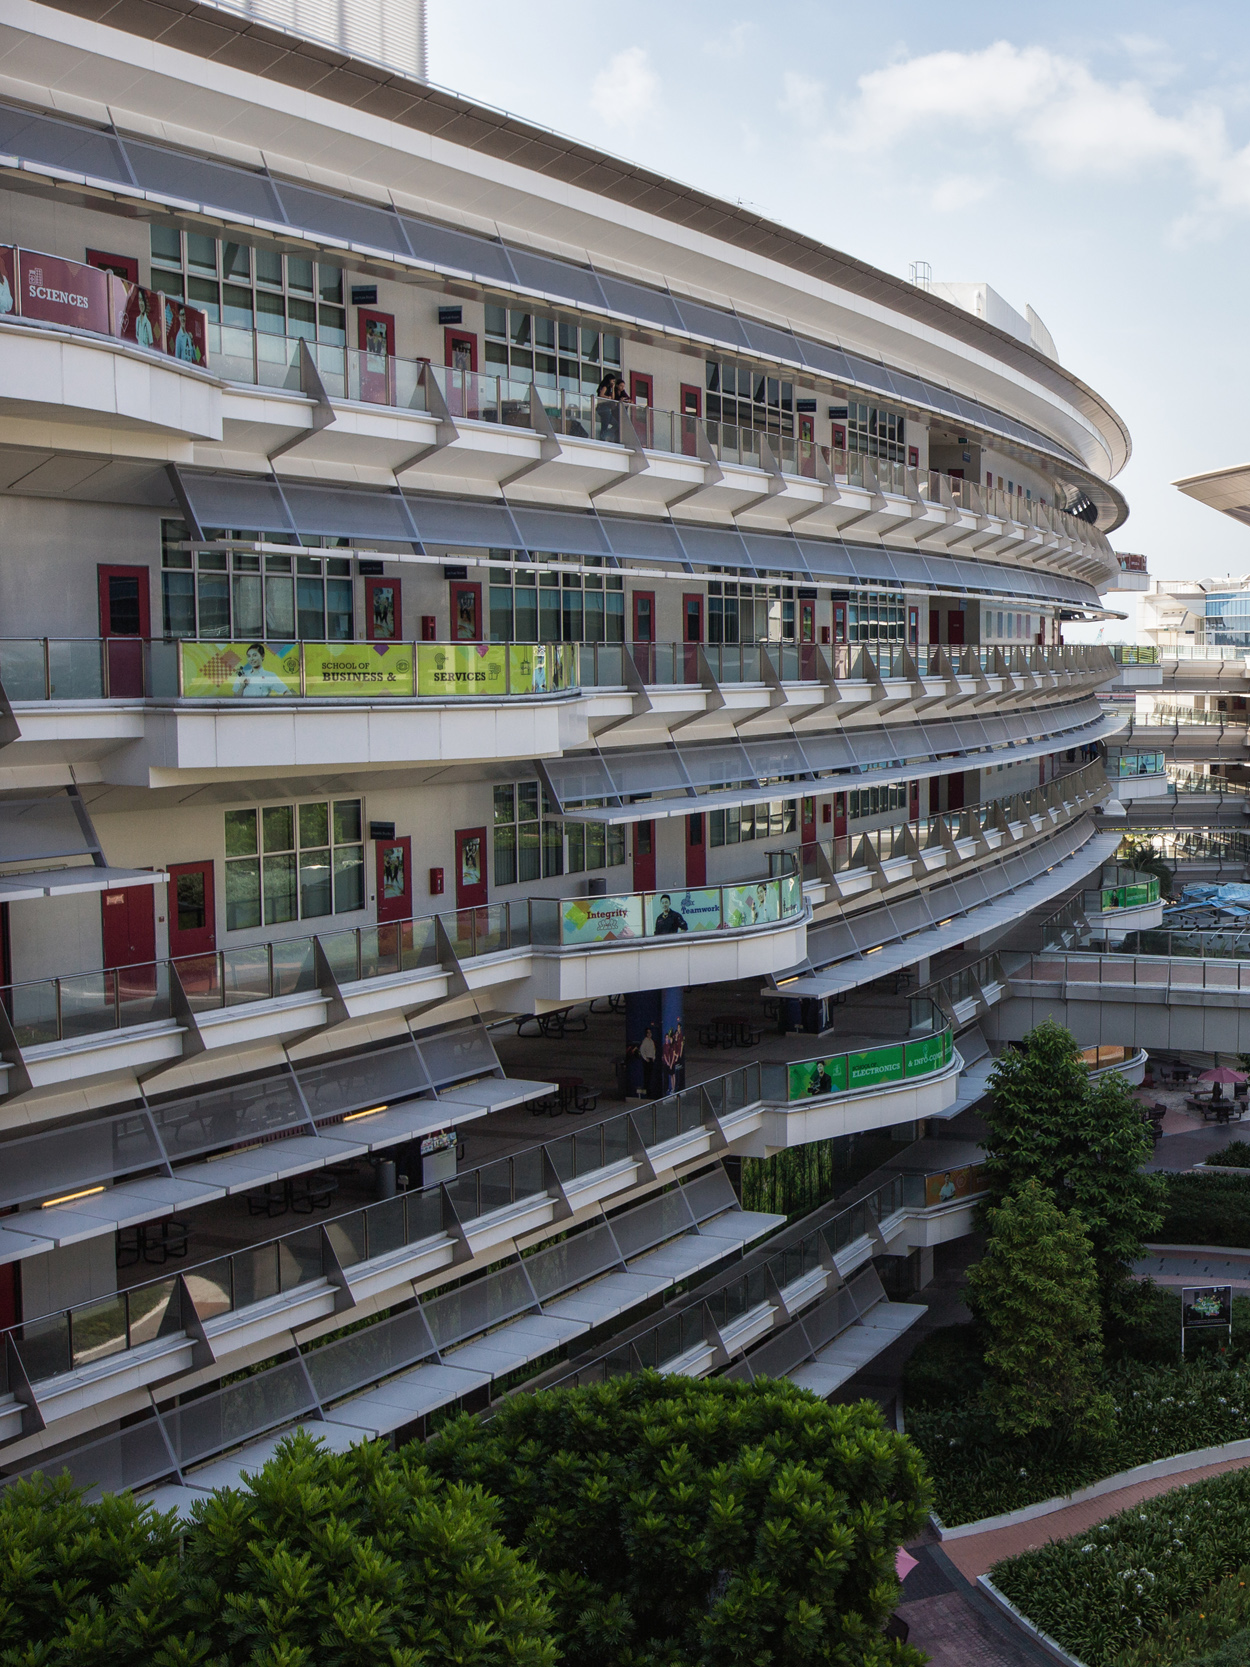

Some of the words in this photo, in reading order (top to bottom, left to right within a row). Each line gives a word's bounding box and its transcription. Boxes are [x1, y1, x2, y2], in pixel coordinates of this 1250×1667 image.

[29, 286, 89, 309] SCIENCES
[321, 662, 357, 670] SCHOOL
[358, 662, 371, 670] OF
[322, 672, 384, 682] BUSINESS
[387, 672, 397, 682] &
[433, 672, 486, 682] SERVICES
[586, 908, 628, 920] Integrity
[681, 904, 720, 915] Teamwork
[852, 1063, 871, 1071] SCHOOL
[852, 1062, 901, 1078] ELECTRONICS
